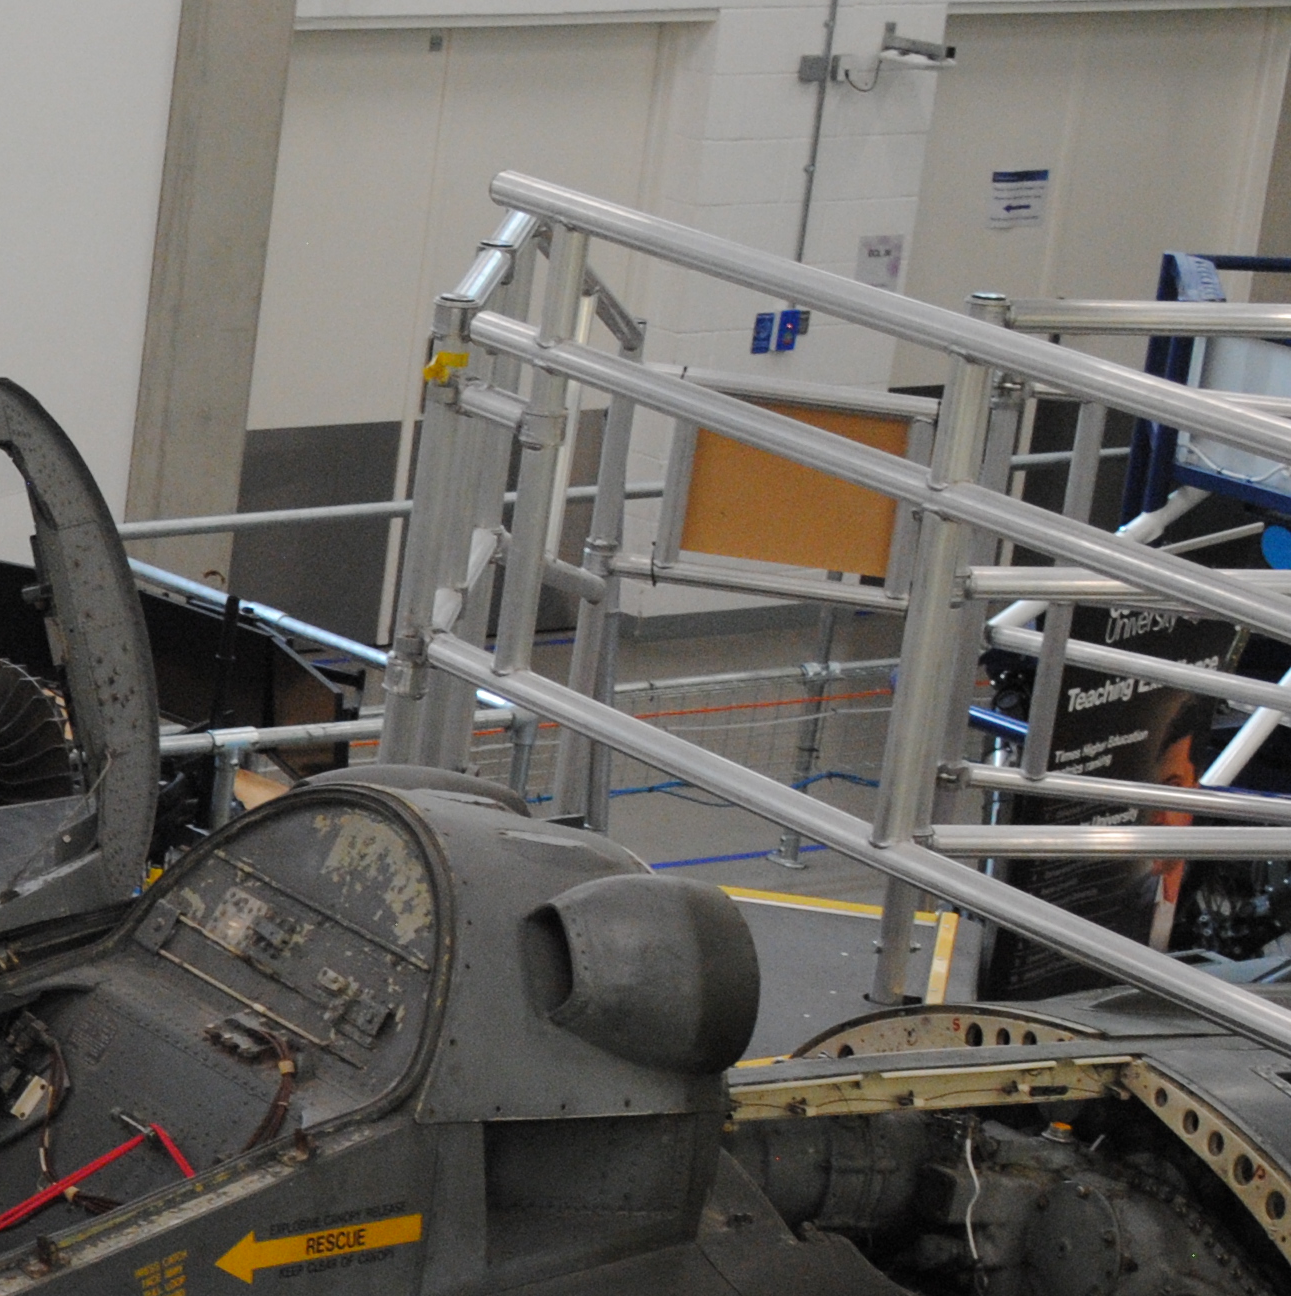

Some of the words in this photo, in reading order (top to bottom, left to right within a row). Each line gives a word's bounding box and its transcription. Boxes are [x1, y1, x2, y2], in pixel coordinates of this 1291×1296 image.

[1068, 678, 1135, 712] Teaching
[1108, 730, 1149, 749] Education
[952, 1016, 961, 1032] S
[323, 1208, 362, 1226] CANOPY
[365, 1201, 406, 1218] RELEASE
[305, 1227, 366, 1256] RESCUE
[357, 1248, 395, 1265] CANOPY
